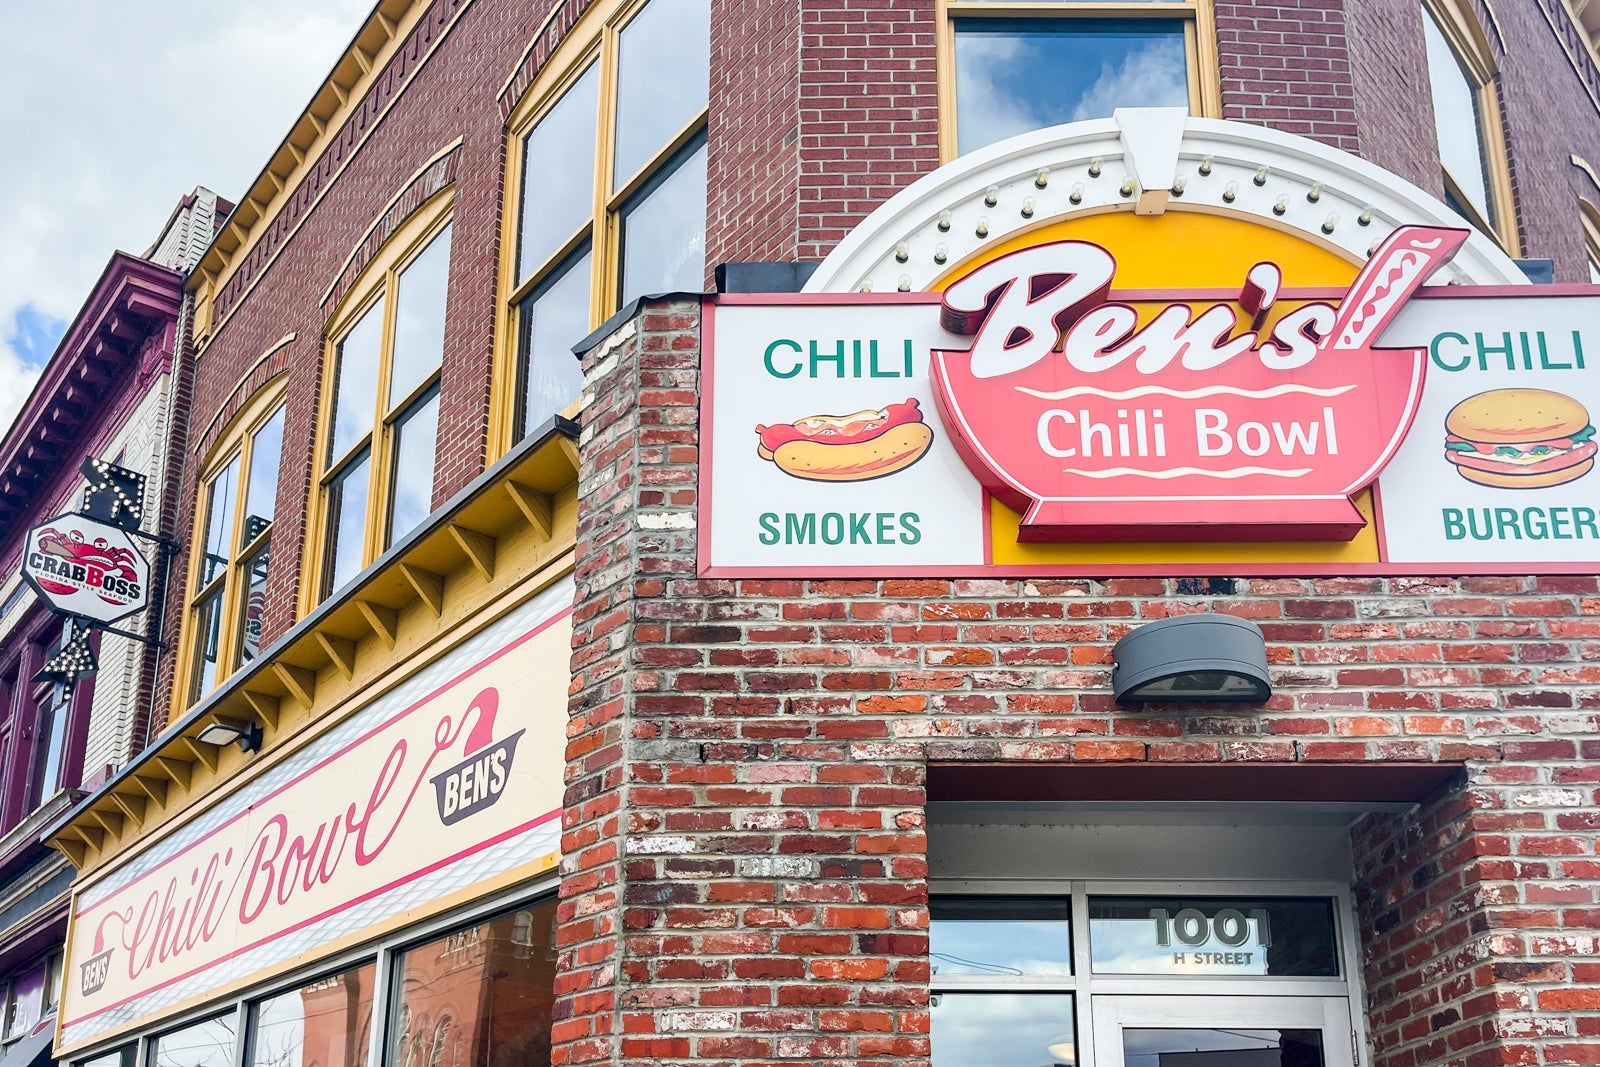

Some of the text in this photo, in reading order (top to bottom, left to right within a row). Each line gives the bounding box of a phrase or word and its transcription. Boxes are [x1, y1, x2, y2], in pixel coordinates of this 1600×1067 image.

[941, 239, 1338, 380] Ben's
[763, 339, 914, 379] CHILI
[1430, 330, 1586, 371] CHILI
[1036, 406, 1339, 458] Chili Bowl
[758, 511, 922, 546] SMOKES
[1441, 506, 1600, 541] BURGER
[35, 570, 133, 604] FLORIDA STYLE SEAFOOD
[443, 747, 507, 819] BEN'S
[122, 738, 408, 981] Chili Bowl
[1149, 908, 1272, 948] 1001
[1173, 951, 1254, 965] H STREET
